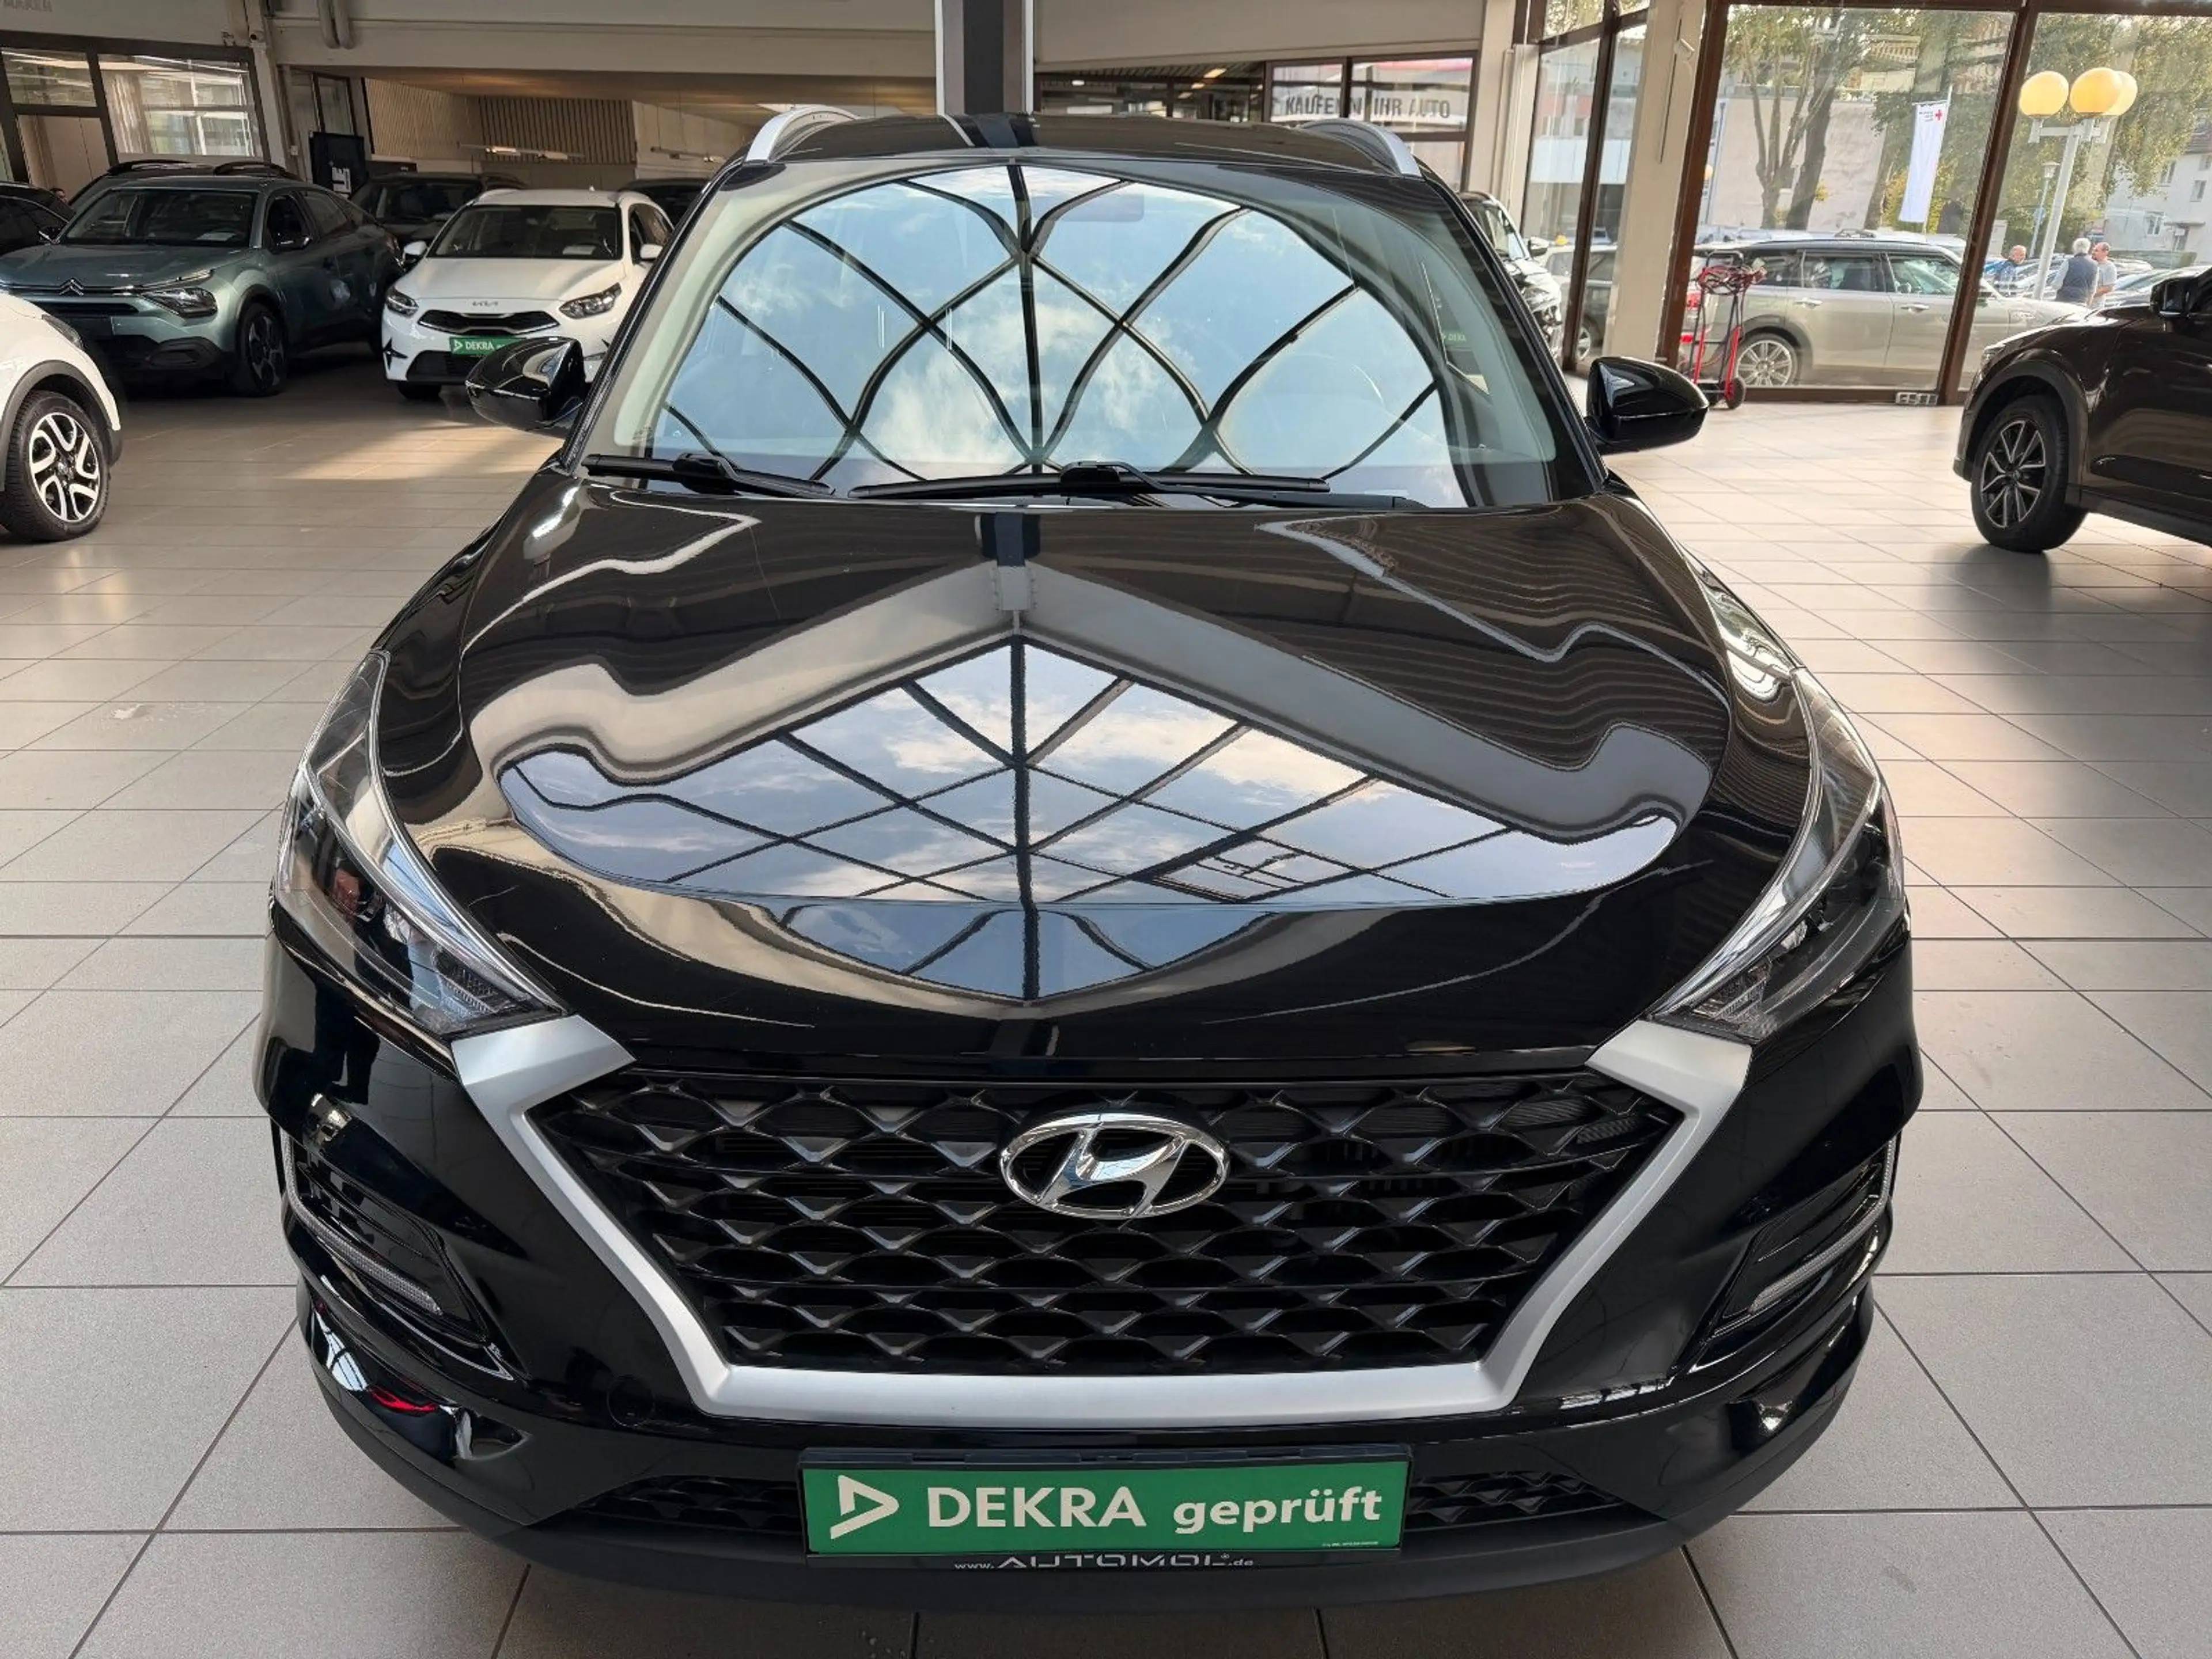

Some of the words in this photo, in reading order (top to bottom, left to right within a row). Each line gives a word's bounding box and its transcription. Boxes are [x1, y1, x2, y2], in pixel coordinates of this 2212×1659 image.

[1374, 97, 1402, 116] IHR
[1409, 97, 1450, 119] AUTO
[465, 340, 495, 351] DEKRA
[927, 1486, 1147, 1528] DEKRA
[1173, 1486, 1382, 1535] geprüft
